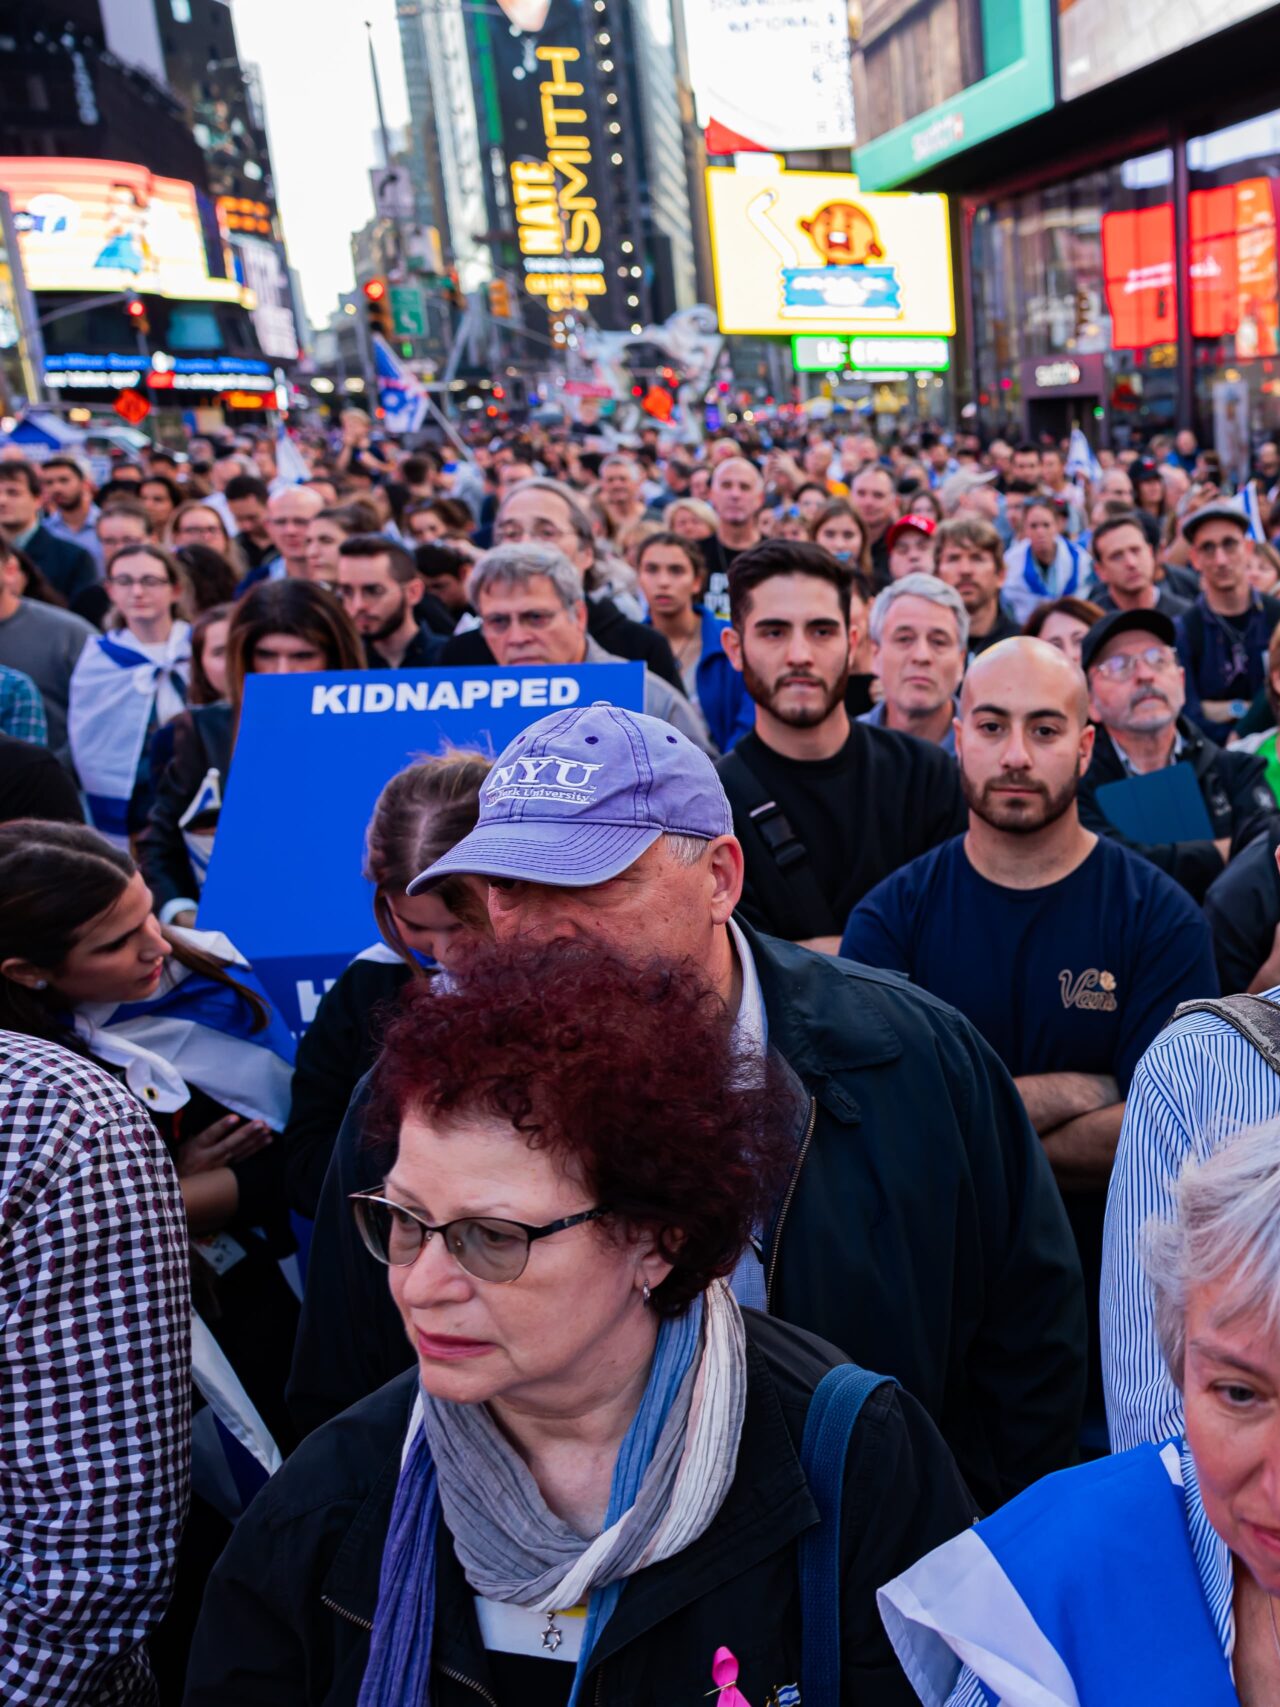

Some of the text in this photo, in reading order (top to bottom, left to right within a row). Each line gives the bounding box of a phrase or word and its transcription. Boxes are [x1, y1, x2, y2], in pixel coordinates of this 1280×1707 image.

[535, 46, 602, 253] SMITH
[510, 161, 564, 254] NATE
[311, 677, 580, 715] KIDNAPPED
[486, 759, 600, 790] NYU
[523, 788, 591, 802] University
[1058, 968, 1117, 1012] Vans
